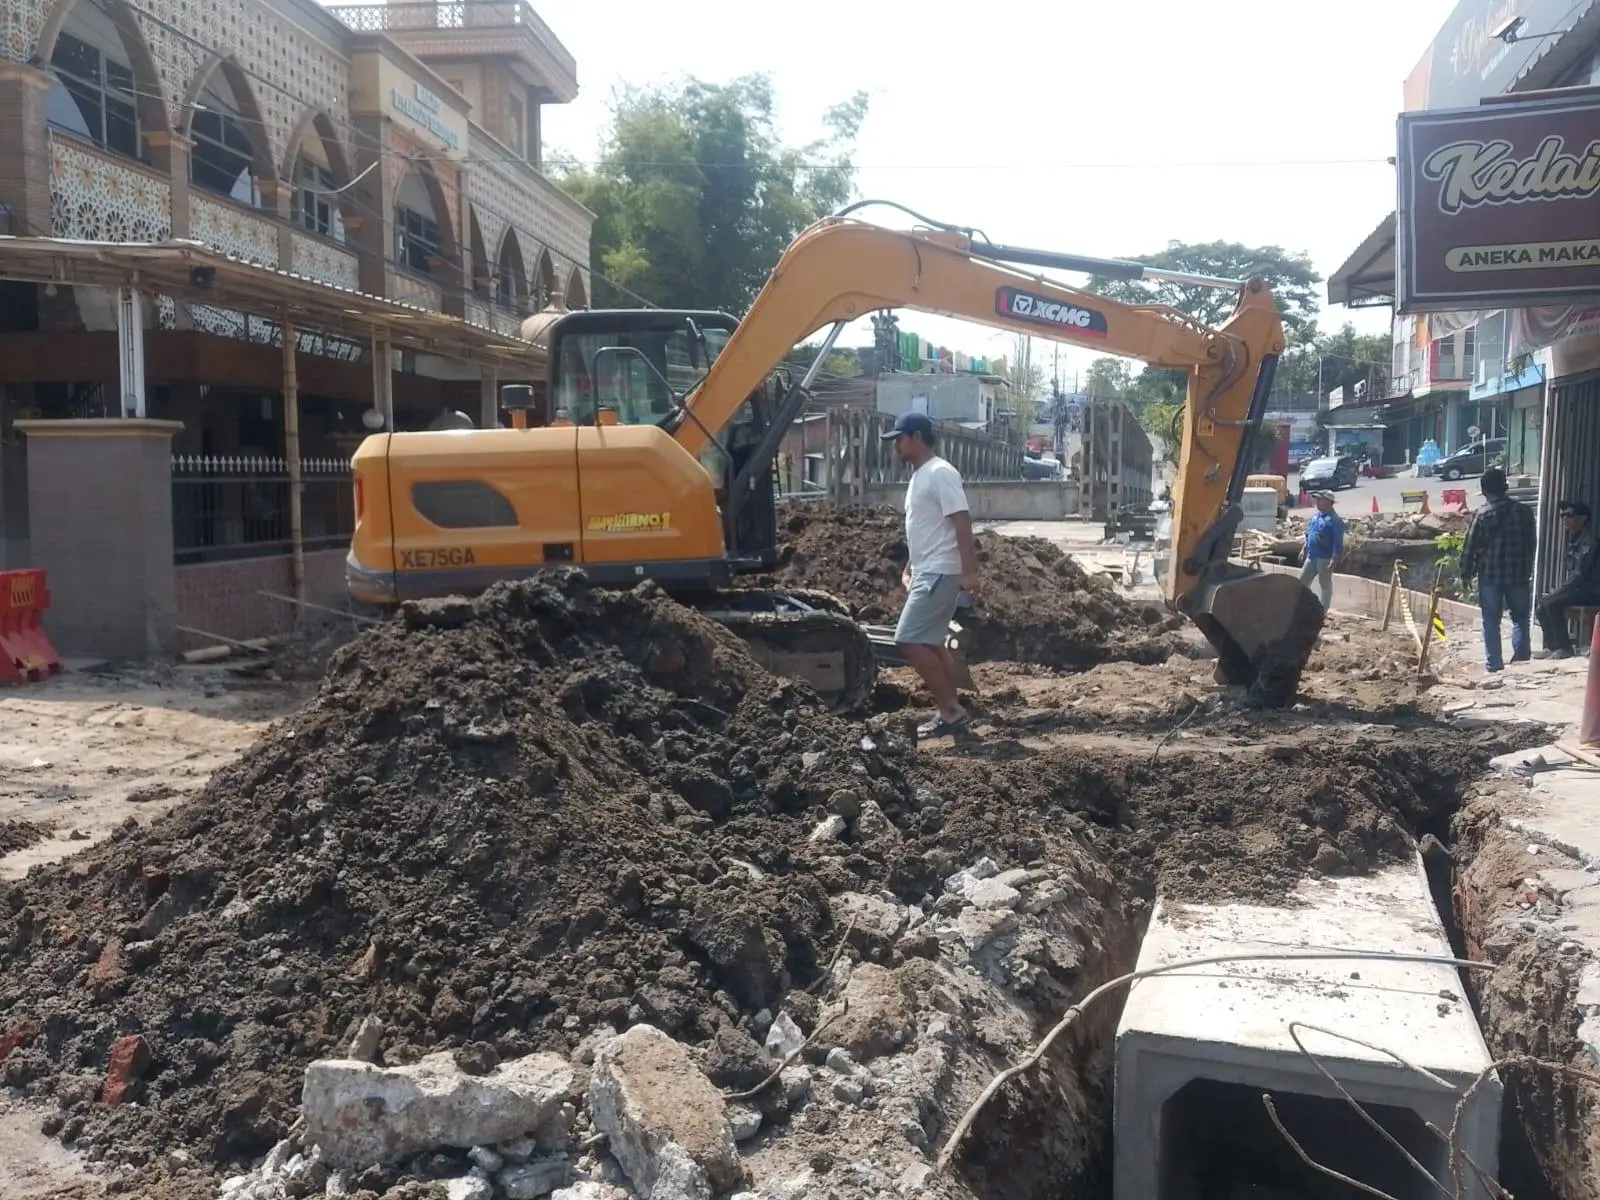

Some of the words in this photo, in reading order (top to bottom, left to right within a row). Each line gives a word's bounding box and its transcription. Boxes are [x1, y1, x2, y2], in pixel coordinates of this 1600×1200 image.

[1422, 136, 1600, 214] Kedai
[1459, 249, 1532, 266] ANEKA
[1539, 245, 1600, 262] MAKA
[1030, 300, 1091, 327] XCMG
[401, 545, 475, 568] XE75GA
